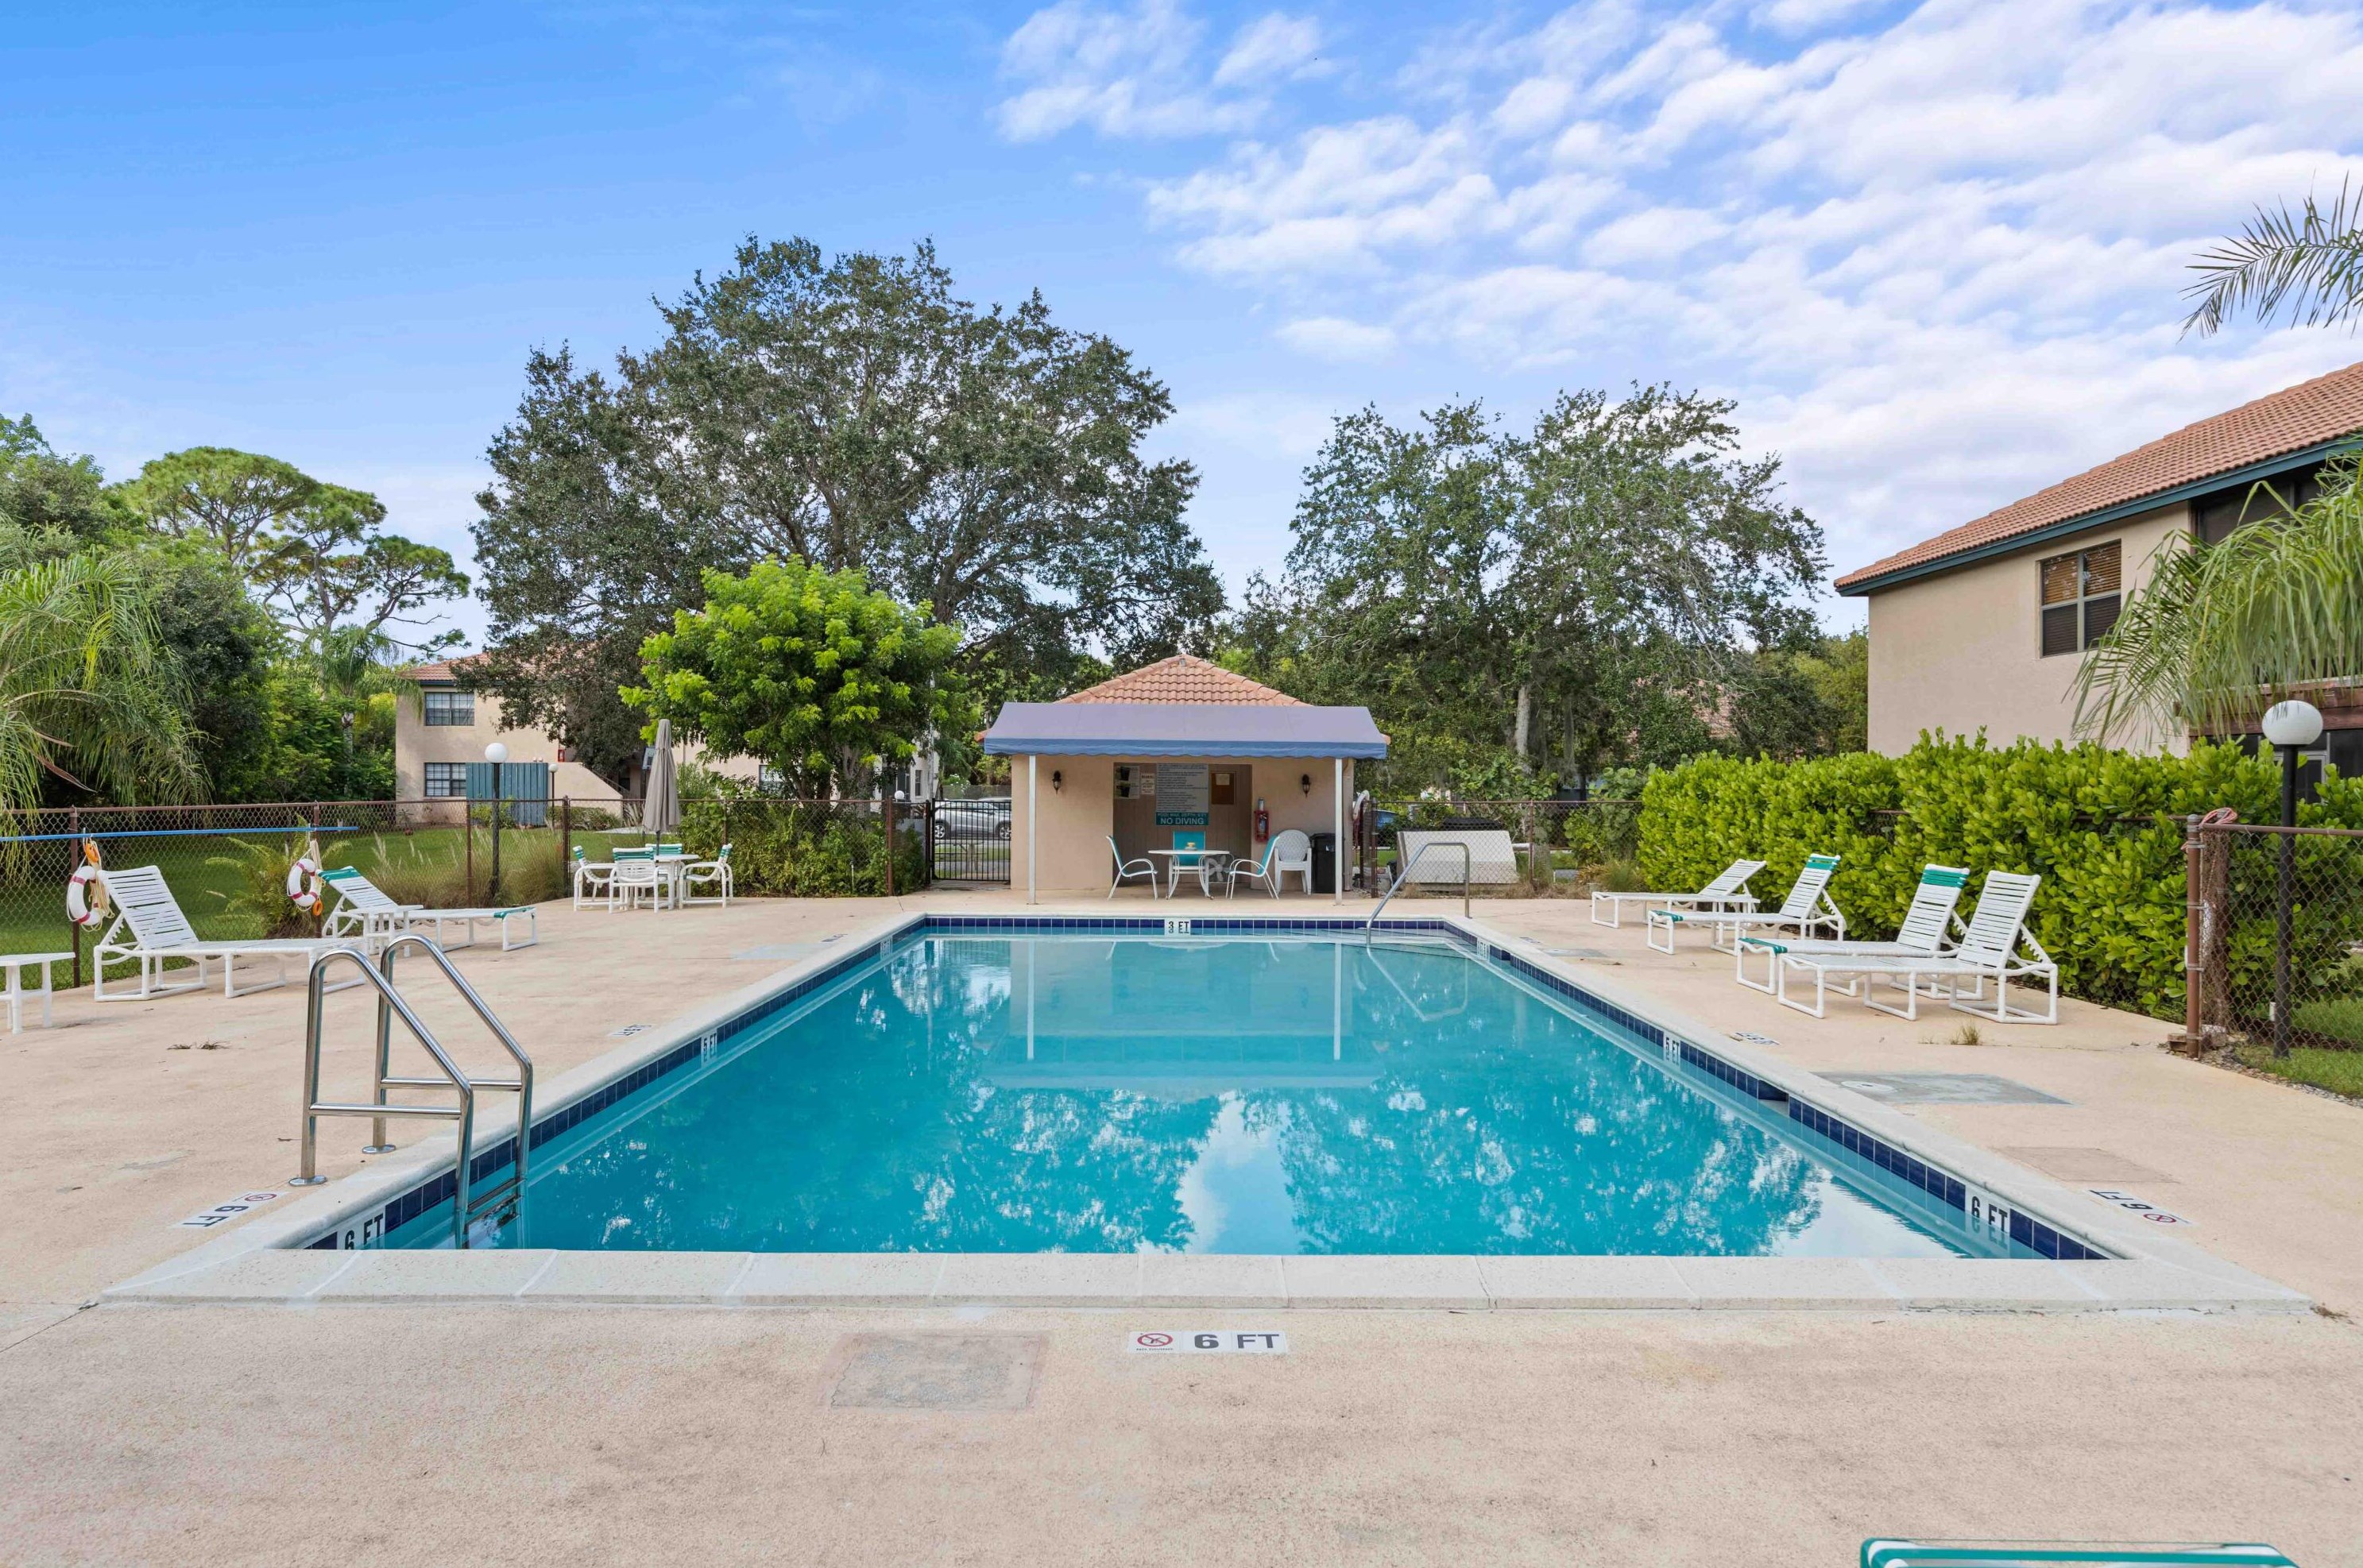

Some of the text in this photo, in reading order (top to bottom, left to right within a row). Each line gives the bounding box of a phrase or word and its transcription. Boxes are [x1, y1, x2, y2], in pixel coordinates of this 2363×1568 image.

[1168, 921, 1174, 929] 3
[703, 1033, 717, 1050] 5 FT
[1666, 1037, 1680, 1054] 5 FT
[2090, 1190, 2133, 1200] FT
[183, 1215, 229, 1226] FT
[1971, 1195, 2008, 1232] 6 FT
[345, 1213, 384, 1249] 6 FT
[1194, 1334, 1280, 1350] 6 FT
